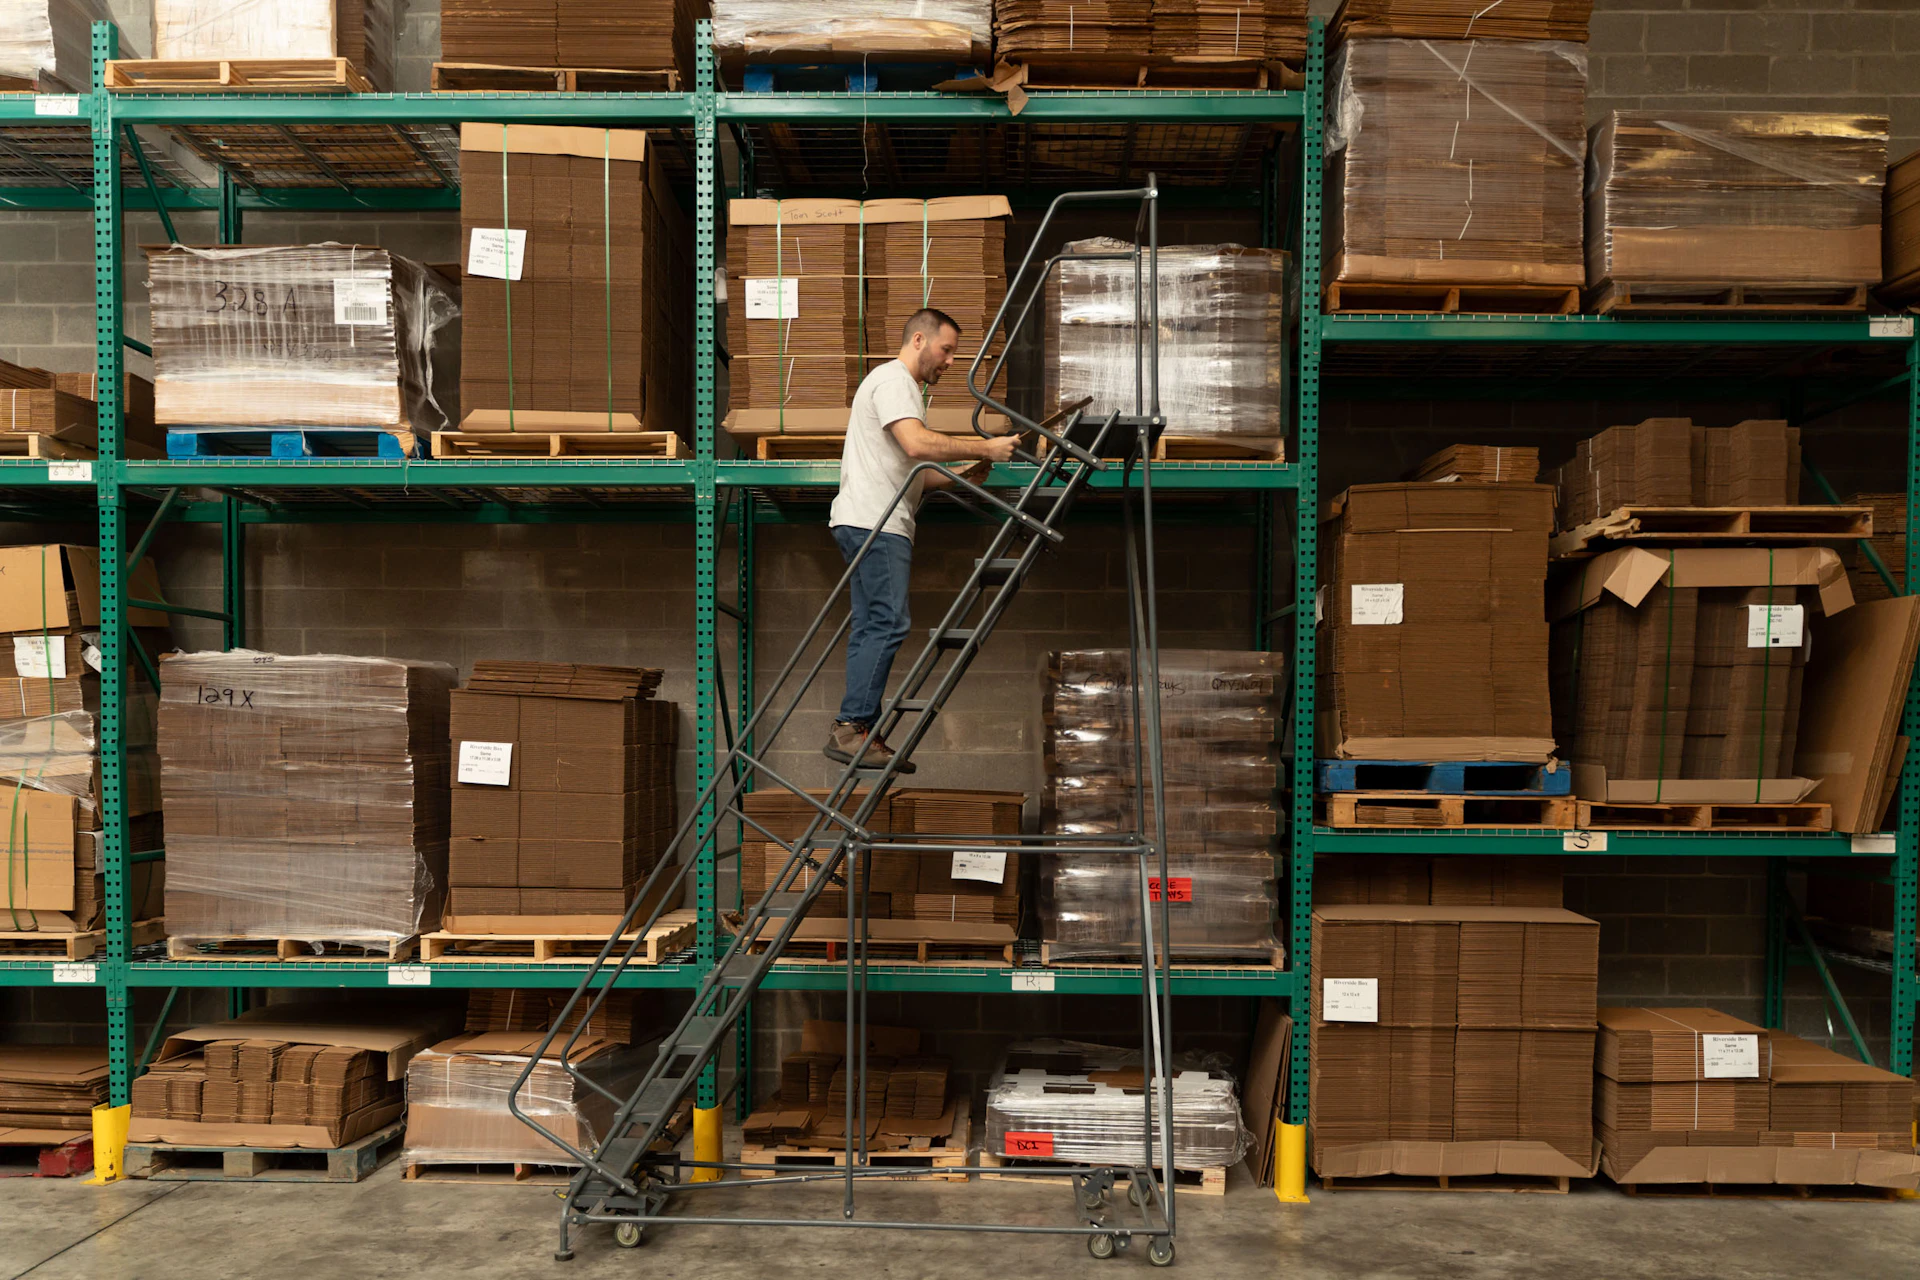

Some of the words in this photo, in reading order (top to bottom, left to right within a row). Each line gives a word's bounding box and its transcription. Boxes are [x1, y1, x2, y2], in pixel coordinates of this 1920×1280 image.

[784, 208, 809, 221] Tom
[815, 208, 845, 218] Scott
[283, 287, 298, 317] A
[1573, 831, 1590, 849] S
[402, 968, 416, 983] Q
[1026, 975, 1037, 987] R
